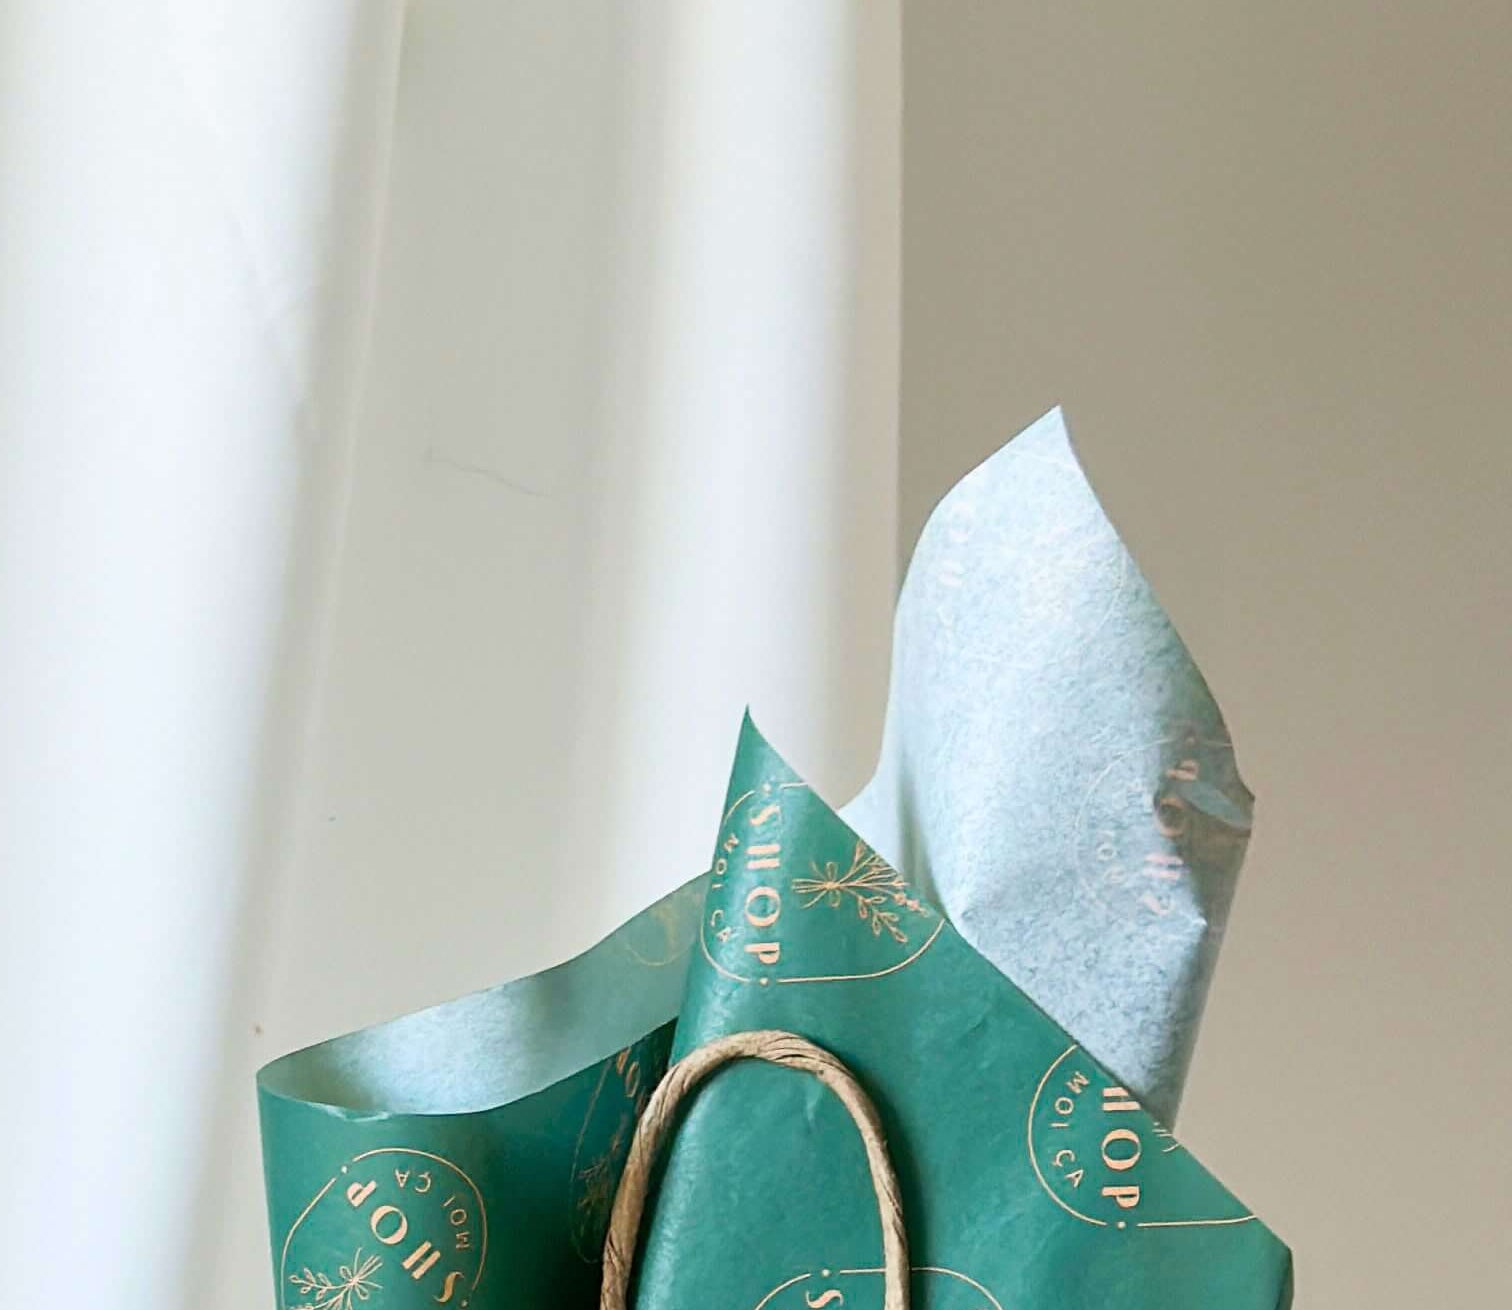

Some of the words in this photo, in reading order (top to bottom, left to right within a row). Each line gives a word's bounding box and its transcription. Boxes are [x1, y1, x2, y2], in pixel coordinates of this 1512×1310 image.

[744, 803, 781, 964] SHOP
[1051, 1071, 1089, 1128] MOI
[1101, 1087, 1142, 1208] HOP
[347, 1180, 465, 1303] SHOP
[442, 1196, 472, 1249] MOI
